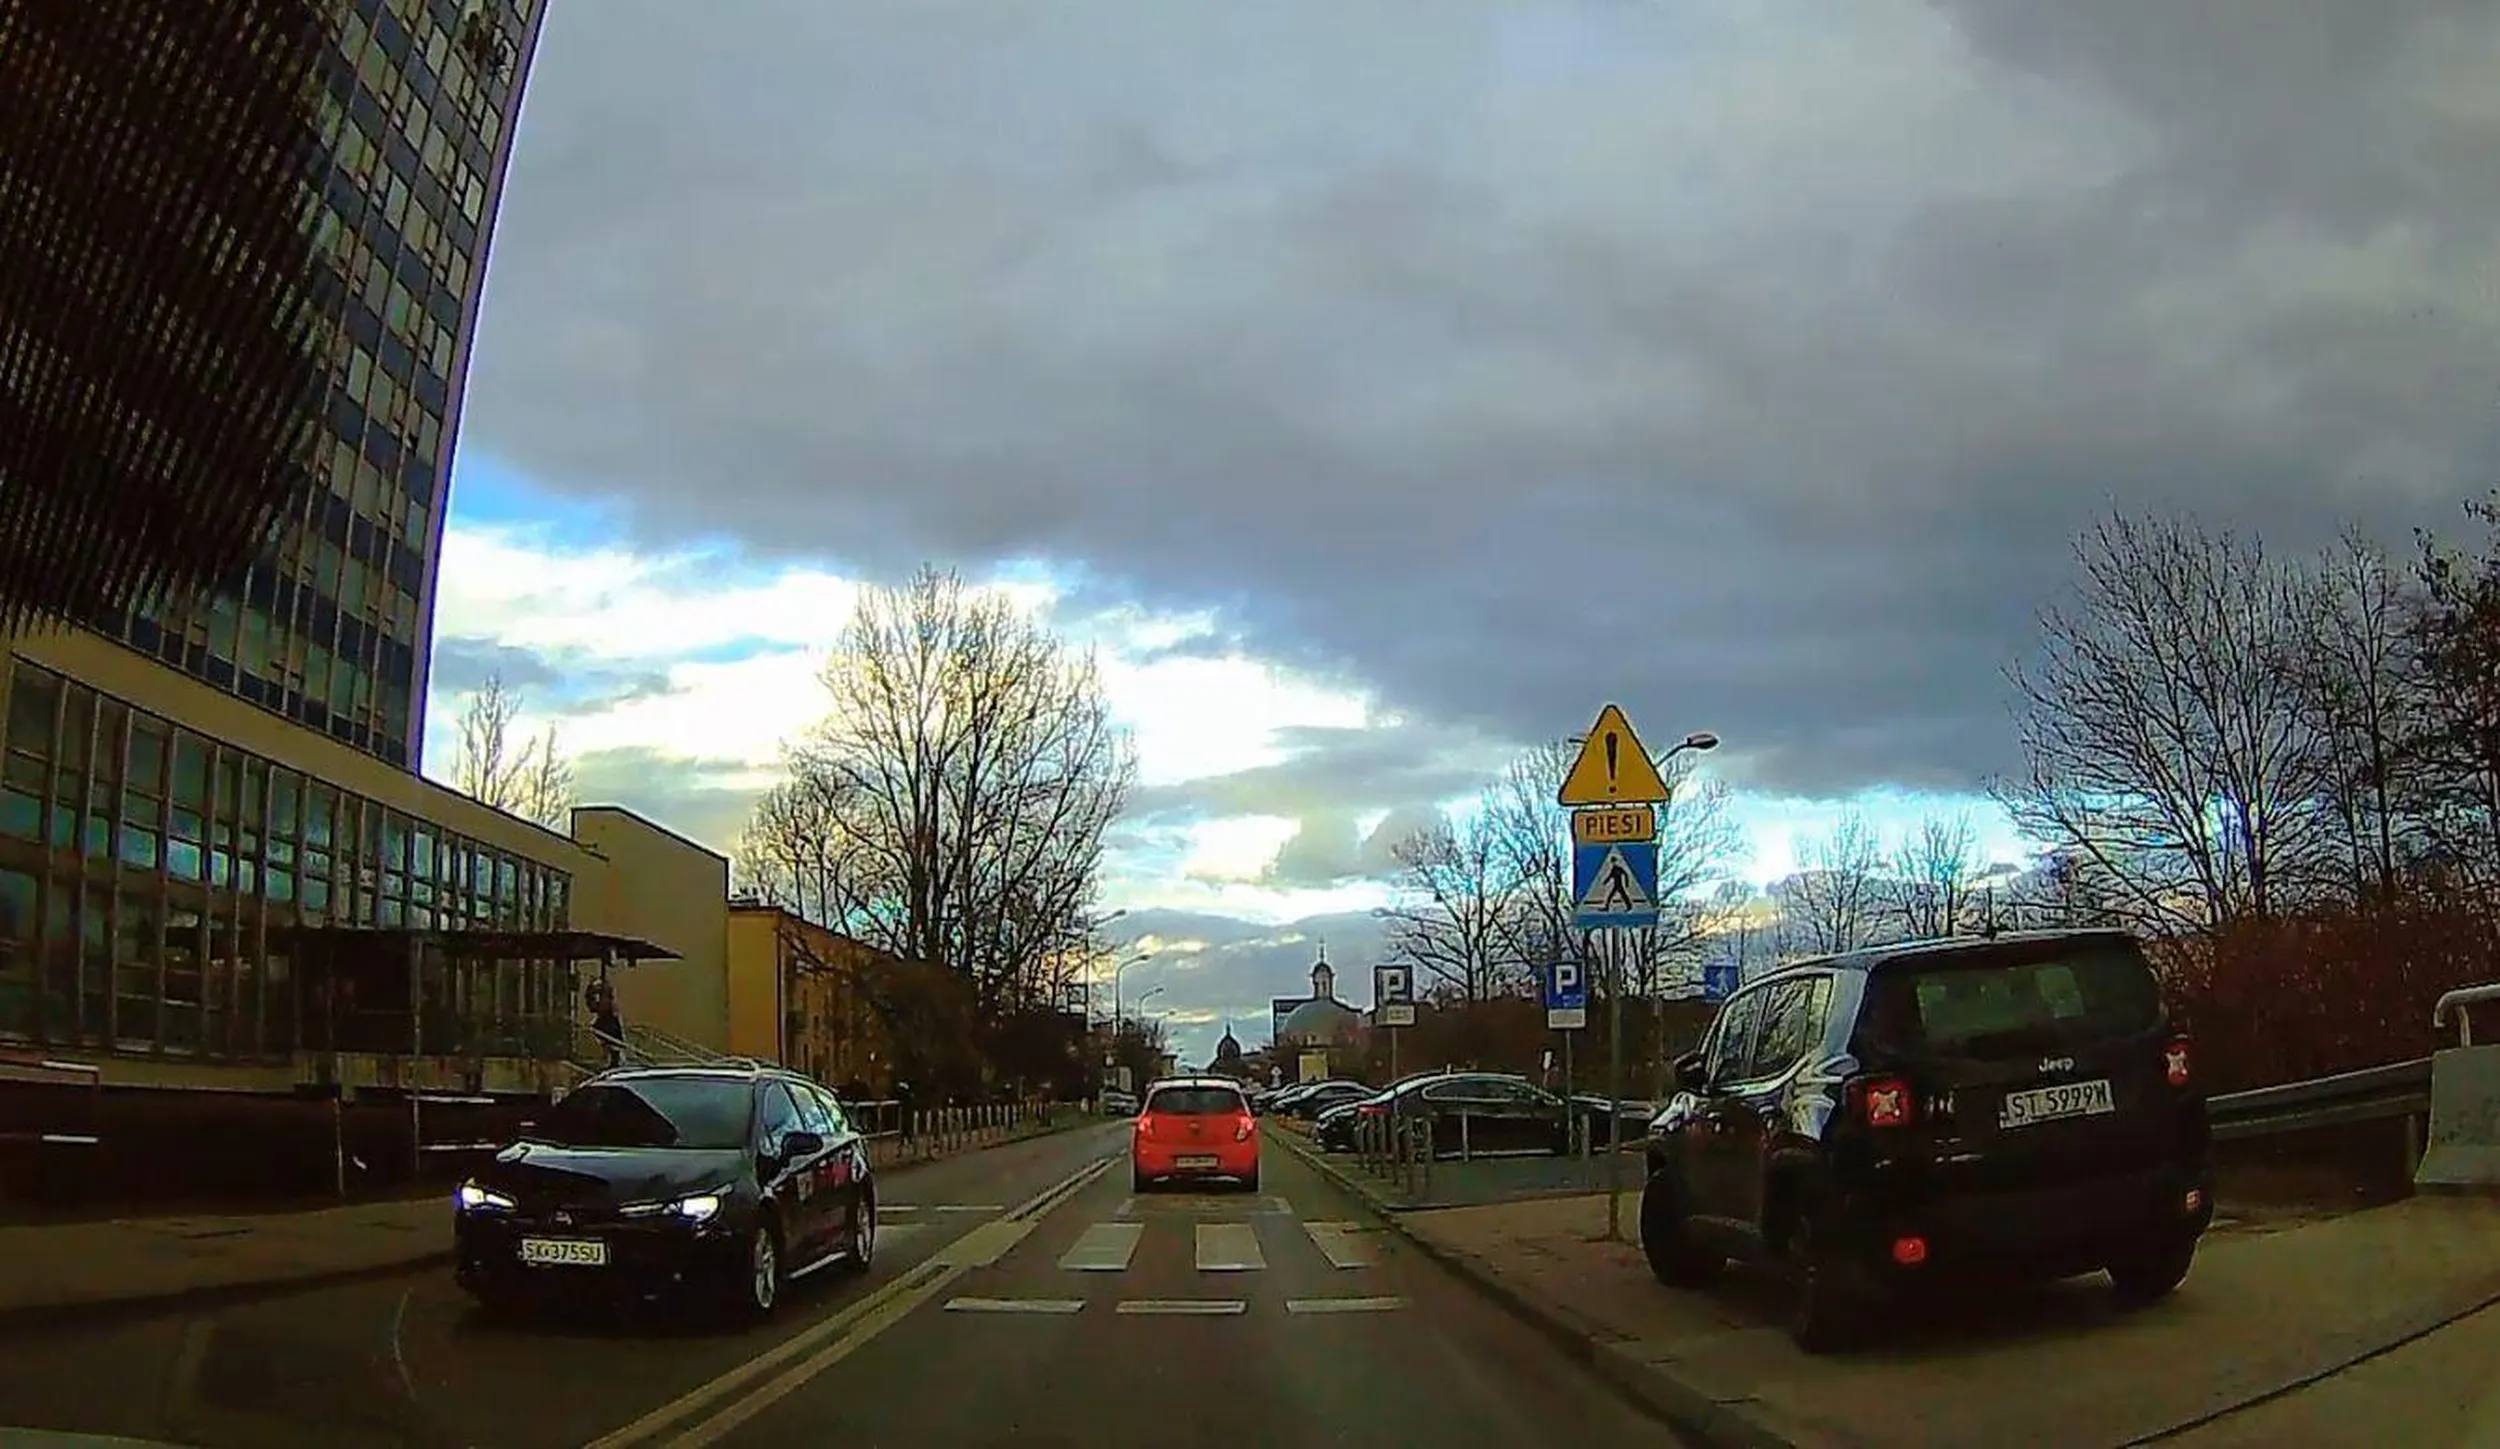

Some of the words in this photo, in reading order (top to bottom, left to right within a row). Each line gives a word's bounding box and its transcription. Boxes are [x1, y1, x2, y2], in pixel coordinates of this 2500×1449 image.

[1585, 814, 1641, 836] PIESI
[1382, 970, 1405, 1001] P
[1556, 964, 1577, 994] P
[2038, 1056, 2076, 1073] Jeep
[2012, 1093, 2037, 1117] ST
